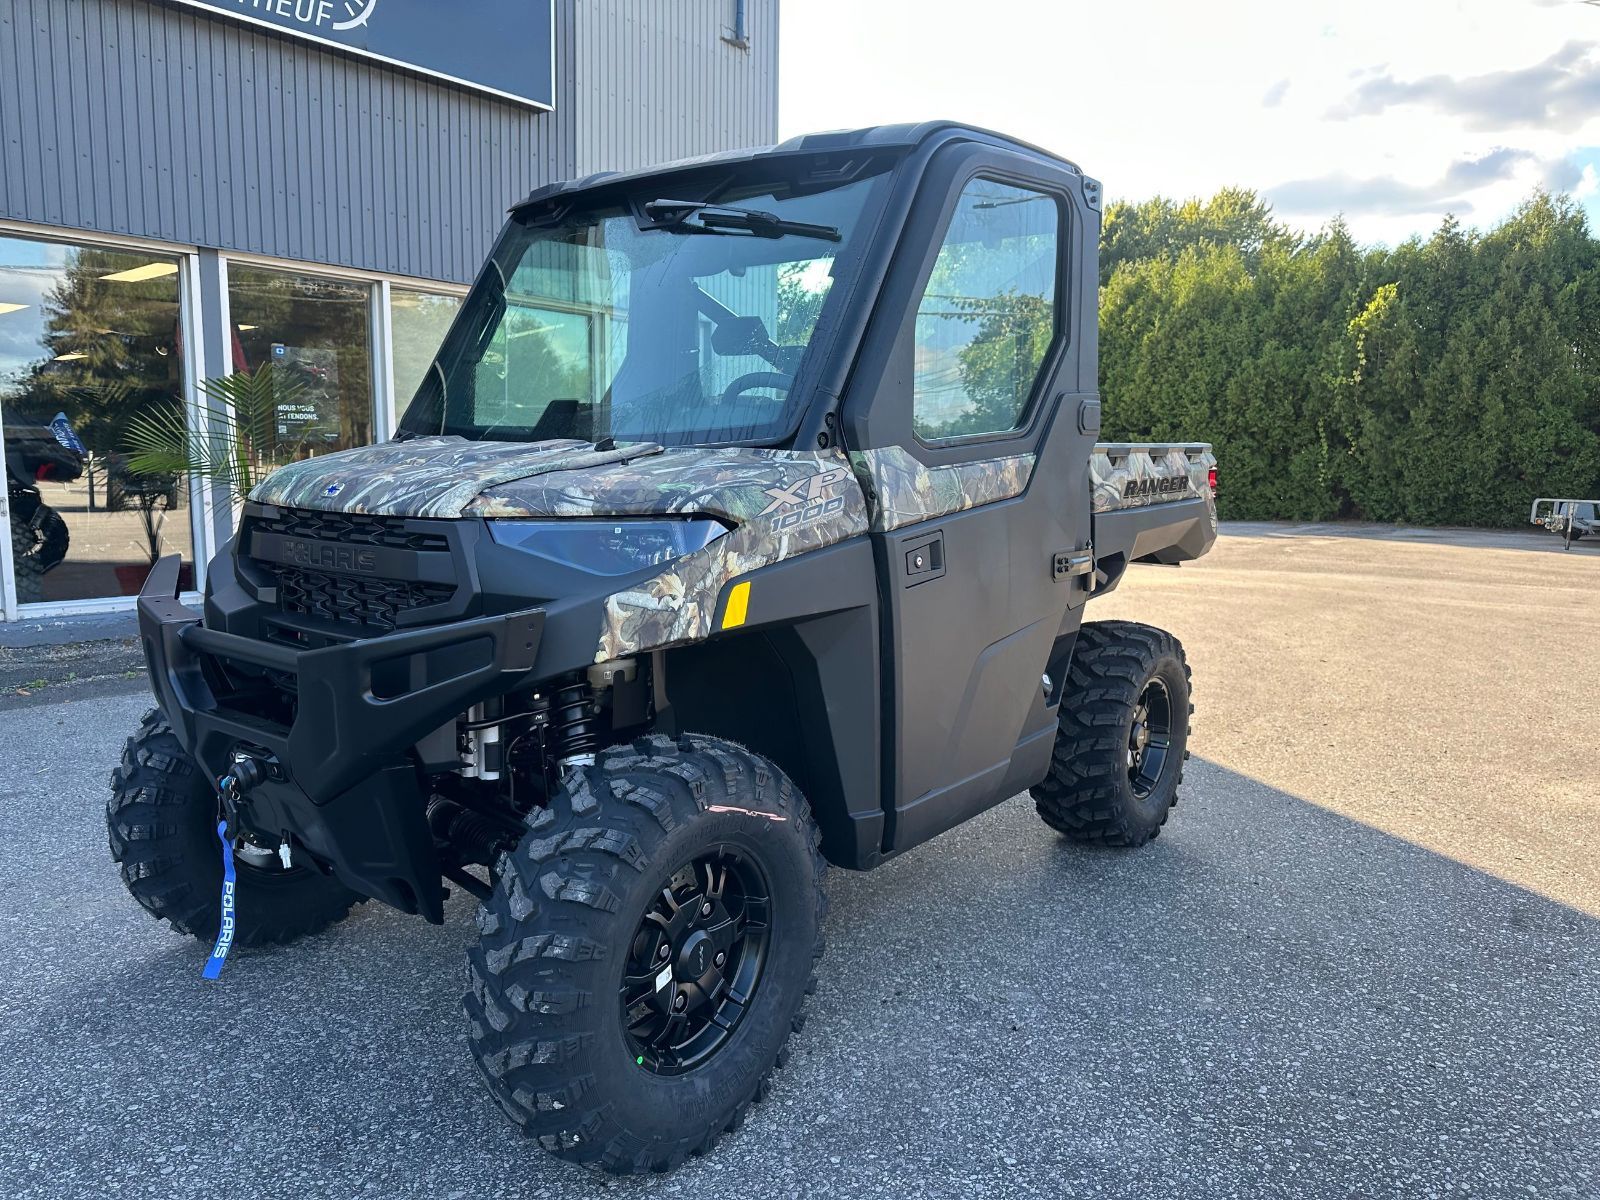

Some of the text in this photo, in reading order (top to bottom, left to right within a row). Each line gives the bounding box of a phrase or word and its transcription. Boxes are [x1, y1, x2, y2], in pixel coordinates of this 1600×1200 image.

[277, 404, 296, 412] NOUS
[752, 467, 849, 519] XP
[1123, 475, 1189, 499] RANGER
[771, 496, 844, 534] 1000
[283, 540, 376, 572] POLARIS
[213, 880, 234, 959] POLARIS
